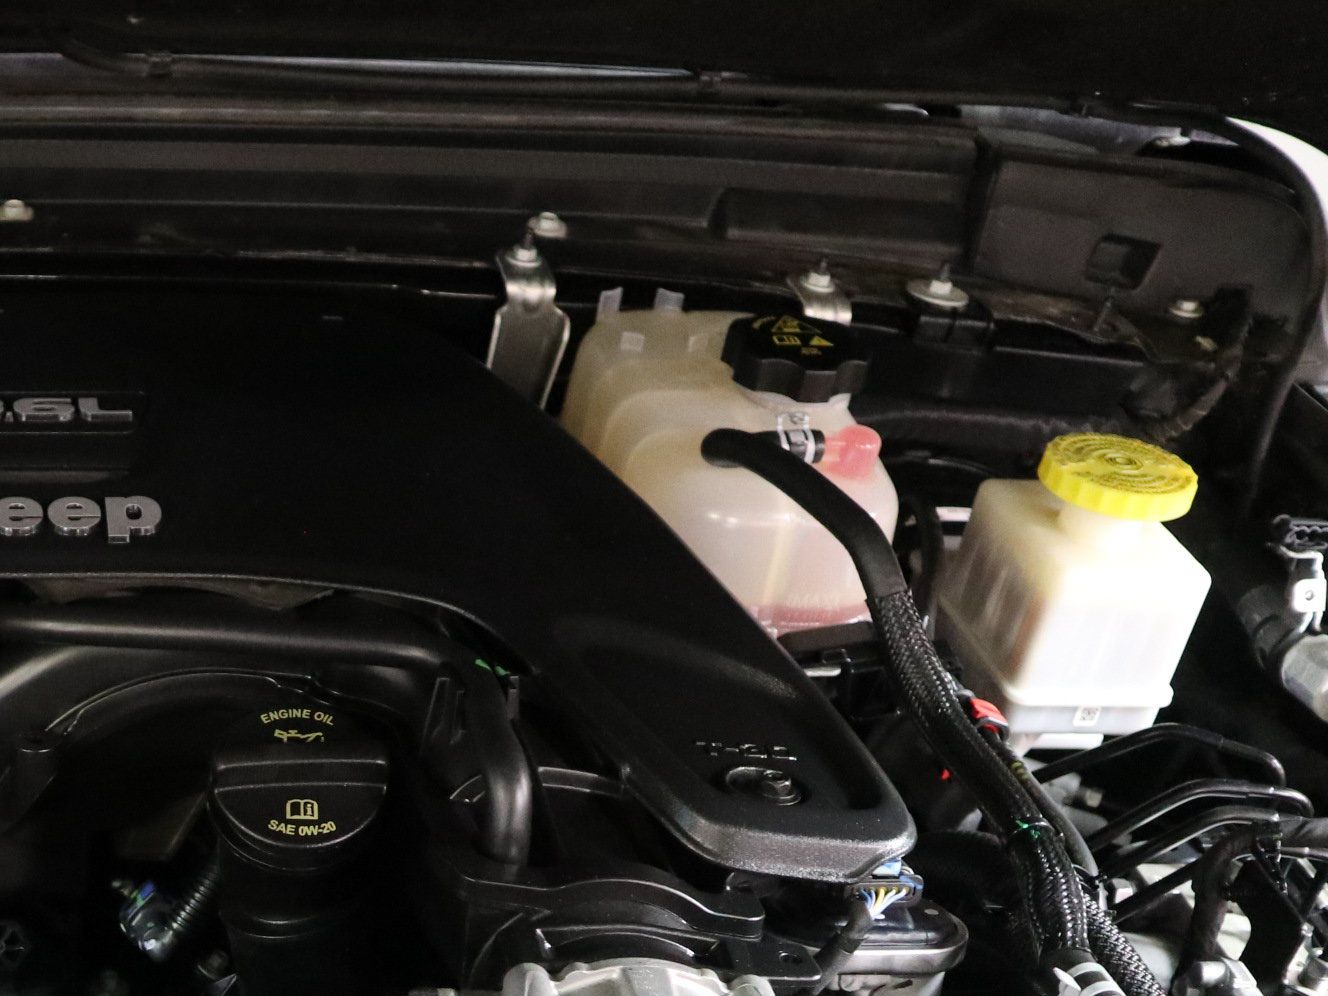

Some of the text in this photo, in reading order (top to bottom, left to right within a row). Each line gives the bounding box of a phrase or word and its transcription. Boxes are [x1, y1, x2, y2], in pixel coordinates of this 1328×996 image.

[260, 708, 334, 726] ENGINE OIL
[268, 819, 337, 836] SAE 0W-20
